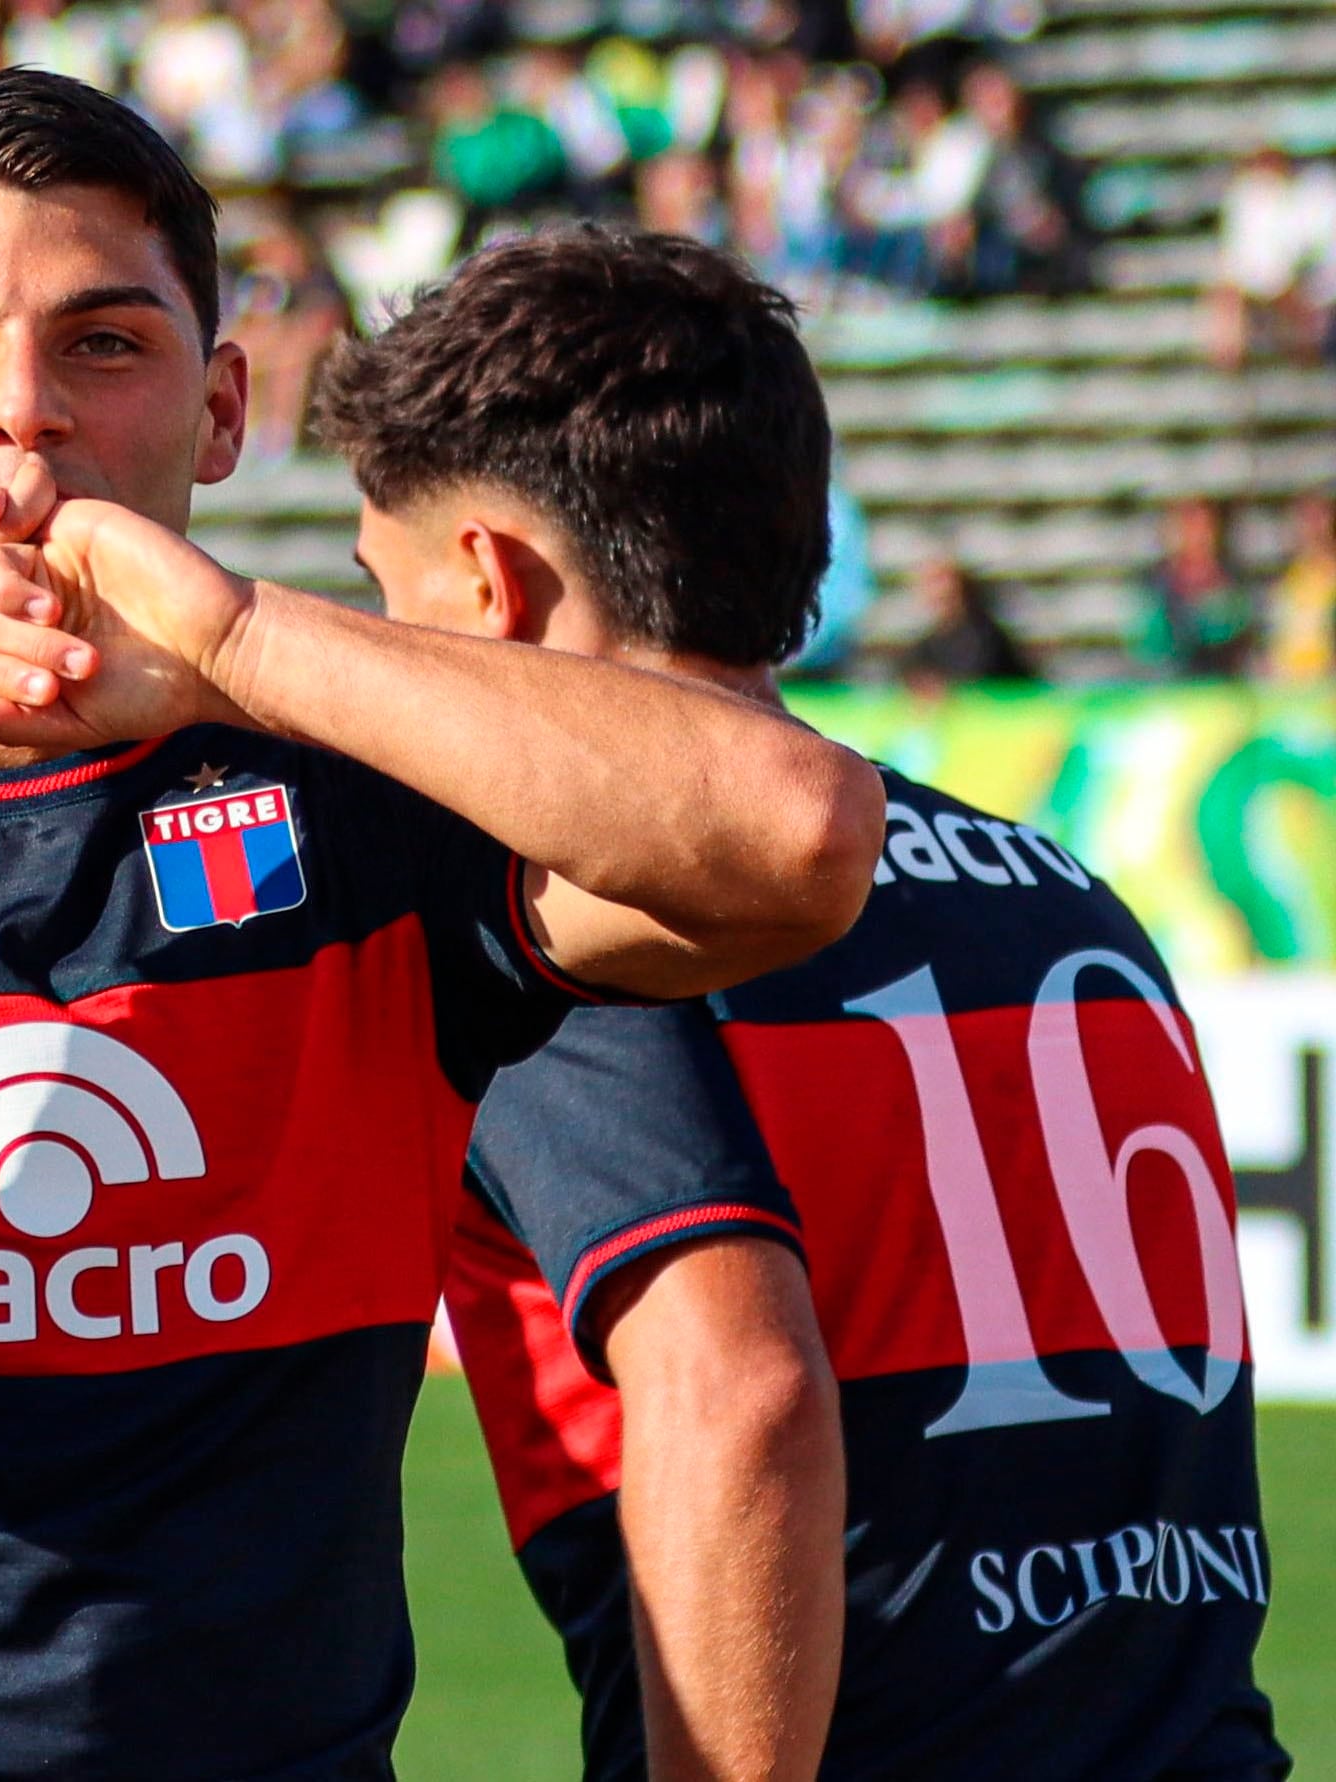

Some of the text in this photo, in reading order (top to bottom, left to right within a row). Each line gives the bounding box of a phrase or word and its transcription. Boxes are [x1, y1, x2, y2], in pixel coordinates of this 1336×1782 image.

[153, 794, 279, 841] TIGRE
[872, 801, 1092, 892] acro
[842, 948, 1245, 1440] 16
